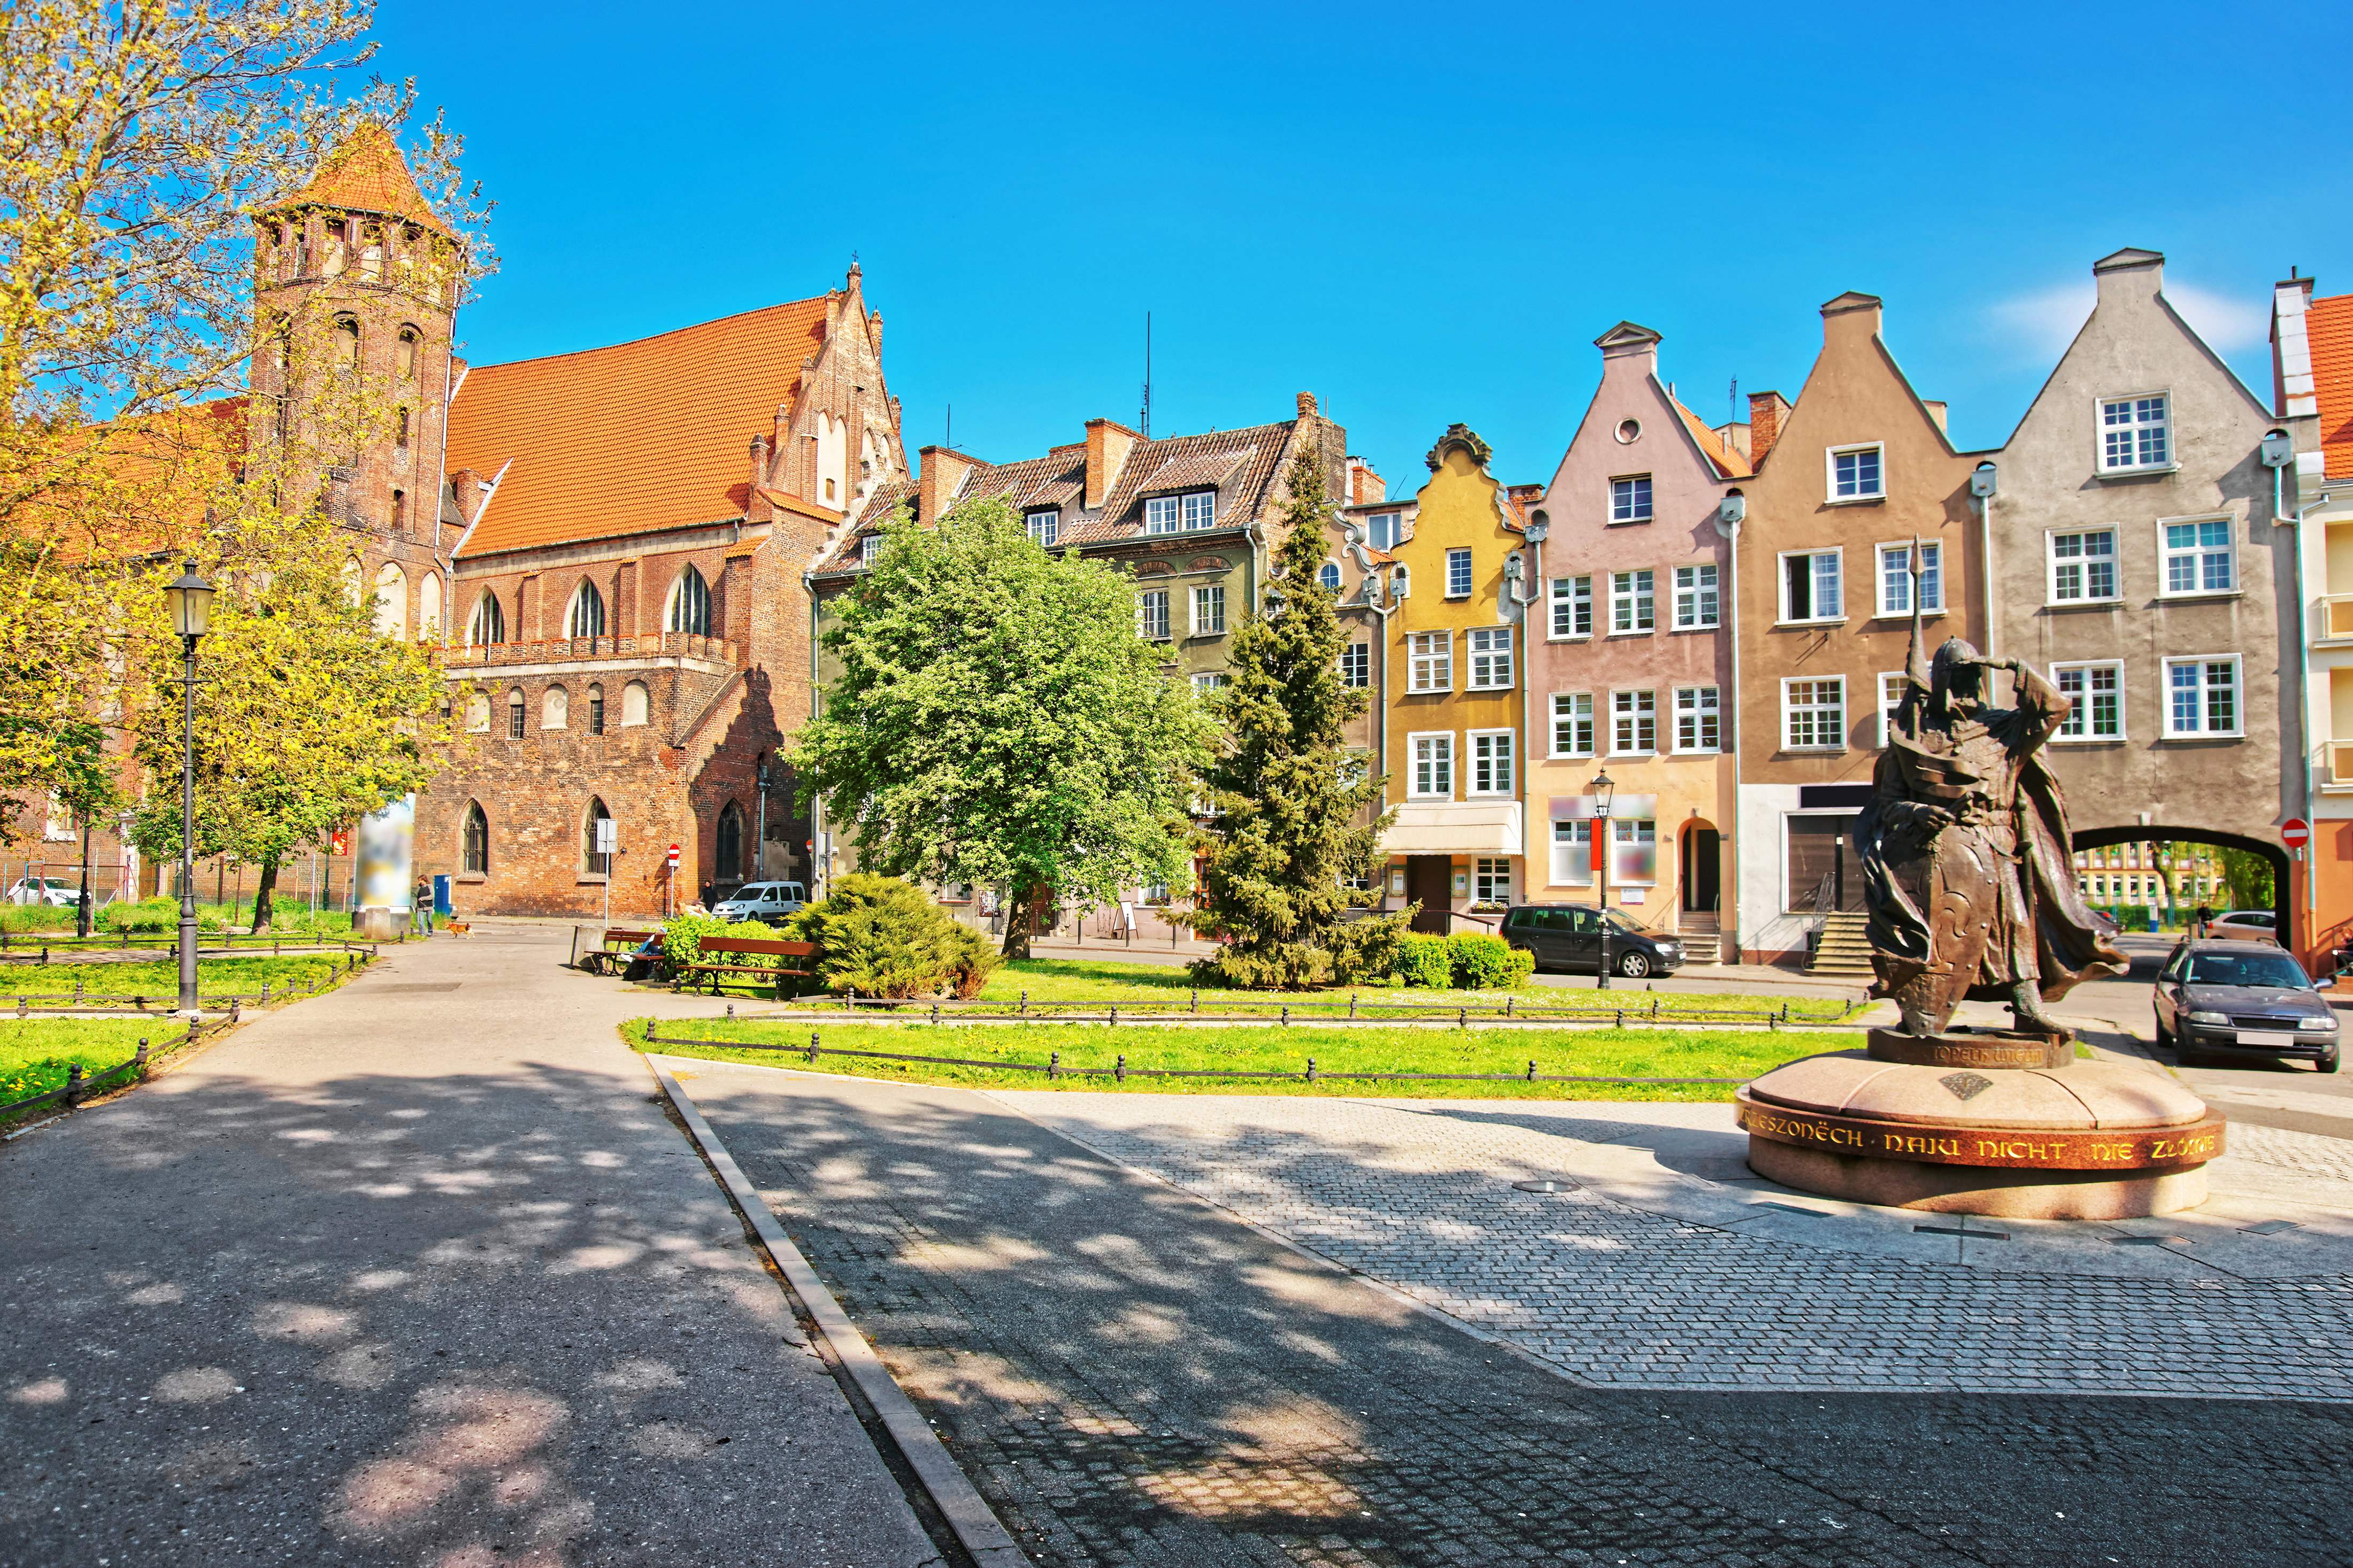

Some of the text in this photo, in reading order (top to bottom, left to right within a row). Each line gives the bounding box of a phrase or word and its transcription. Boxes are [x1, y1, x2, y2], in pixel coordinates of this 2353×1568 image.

[1884, 1134, 1961, 1155] NAJU
[1977, 1141, 2067, 1160] NICHT
[2090, 1143, 2135, 1161] NIE
